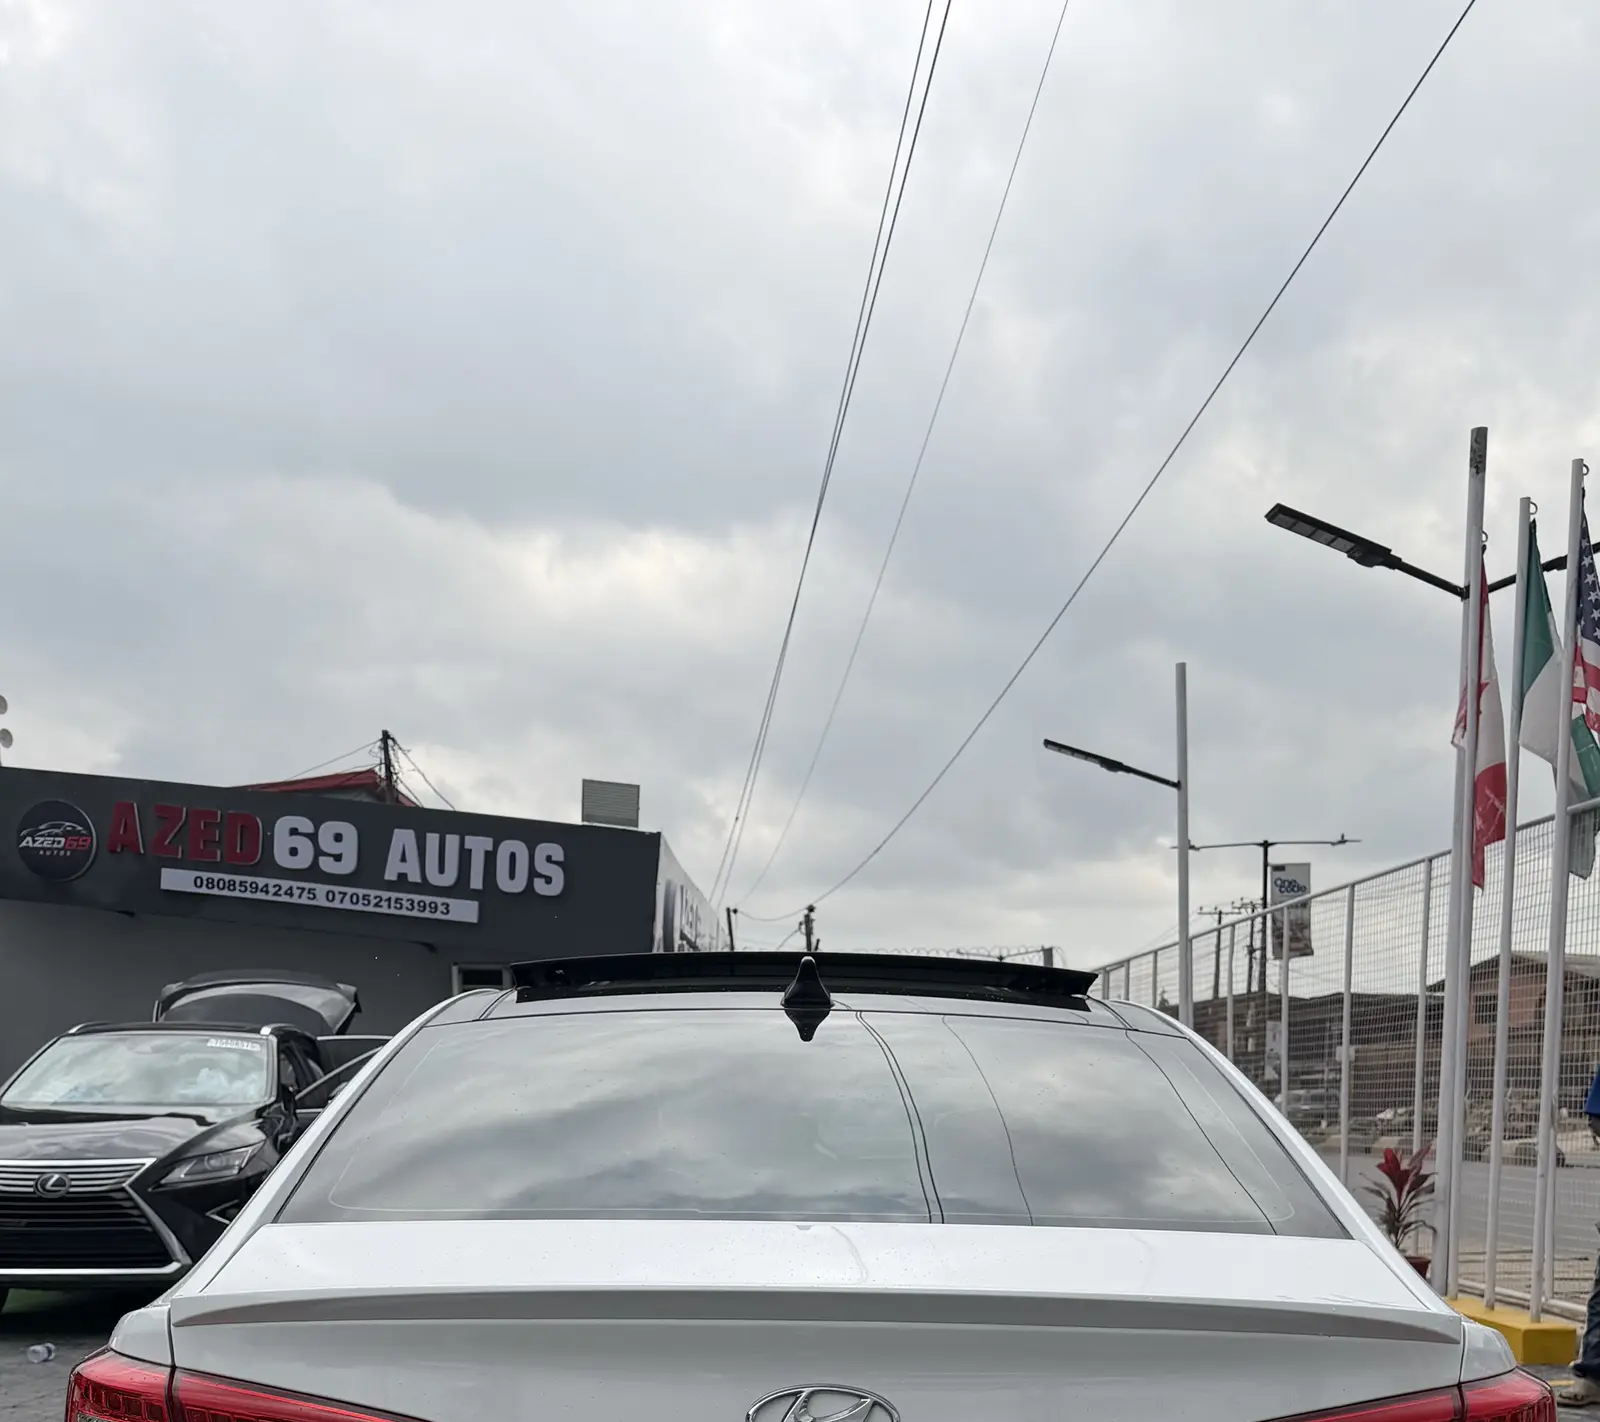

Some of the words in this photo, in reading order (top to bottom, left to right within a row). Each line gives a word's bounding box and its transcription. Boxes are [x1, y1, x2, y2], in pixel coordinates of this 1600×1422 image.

[107, 800, 263, 866] AZED
[273, 815, 359, 875] 69
[383, 828, 565, 896] AUTOS
[193, 876, 317, 901] 08085942475
[325, 890, 450, 915] 07052153993
